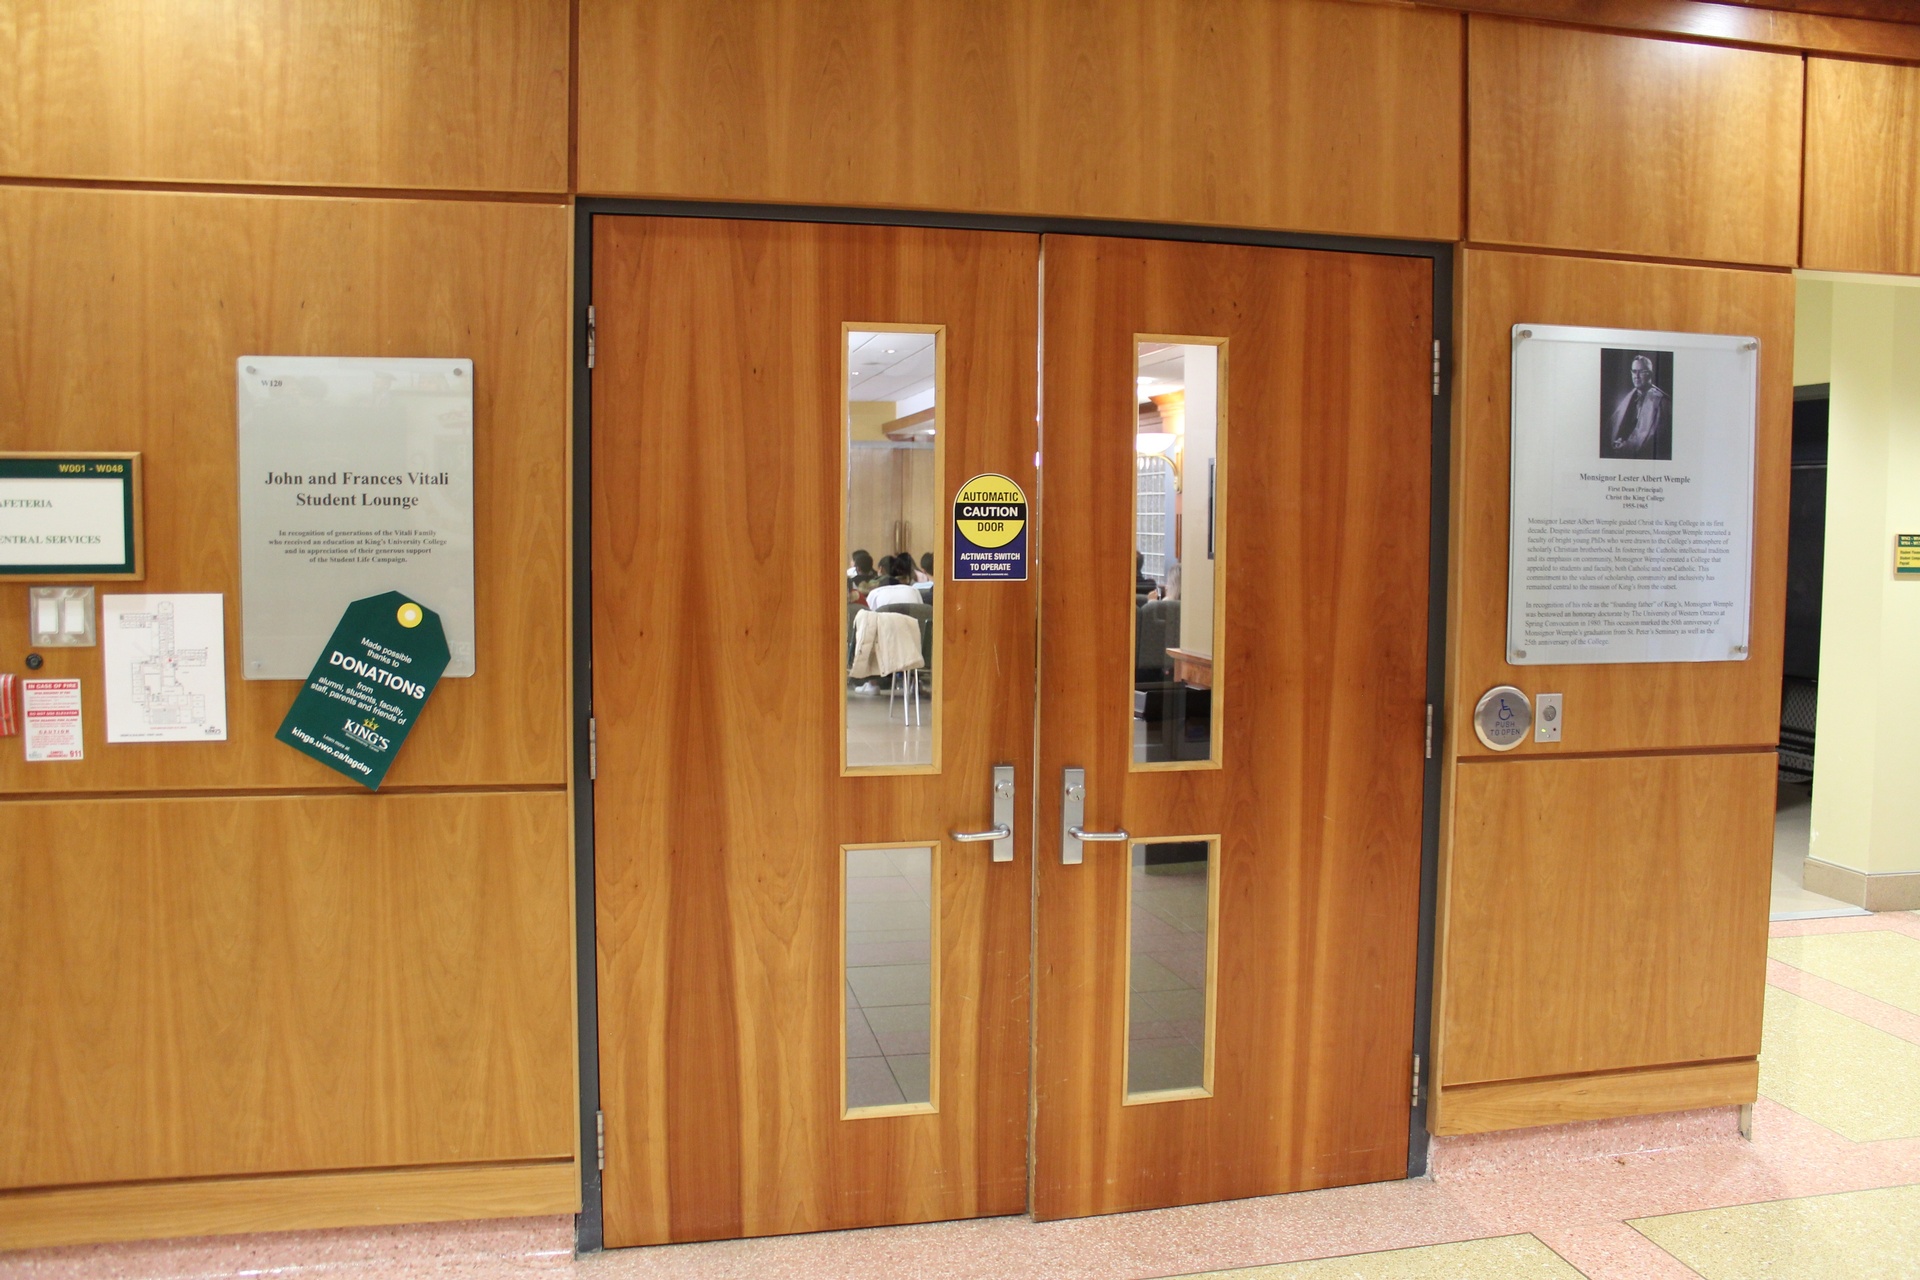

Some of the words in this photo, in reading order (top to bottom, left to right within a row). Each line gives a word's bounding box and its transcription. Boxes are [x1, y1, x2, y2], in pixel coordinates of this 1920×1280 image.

[261, 380, 283, 388] W120
[58, 464, 87, 473] W001
[96, 464, 124, 473] W048
[265, 472, 303, 485] John
[308, 472, 336, 485] and
[342, 472, 402, 485] Frances
[407, 472, 449, 485] Vitali
[1580, 473, 1616, 483] Monsignor
[1618, 474, 1639, 482] Lester
[1640, 475, 1662, 483] Albert
[1663, 476, 1691, 485] Wemple
[296, 493, 356, 507] Student
[362, 493, 419, 510] Lounge
[963, 491, 1019, 502] AUTOMATIC
[963, 506, 1018, 517] CAUTION
[977, 522, 1004, 531] DOOR
[46, 535, 101, 544] SERVICES
[970, 563, 979, 571] TO
[981, 563, 1011, 571] OPERATE
[361, 637, 382, 651] Made
[383, 646, 412, 664] possible
[367, 649, 391, 663] thanks
[391, 658, 400, 668] to
[329, 650, 426, 699] DONATIONS
[356, 681, 374, 694] from
[319, 676, 345, 692] alumni,
[346, 687, 378, 706] students,
[379, 700, 404, 717] faculty,
[310, 682, 328, 696] staff,
[329, 690, 356, 707] parents
[357, 701, 372, 712] and
[372, 706, 397, 722] friends
[397, 718, 407, 726] of
[344, 718, 390, 750] KING'S
[292, 726, 373, 776] kings.uwo.ca/tagday
